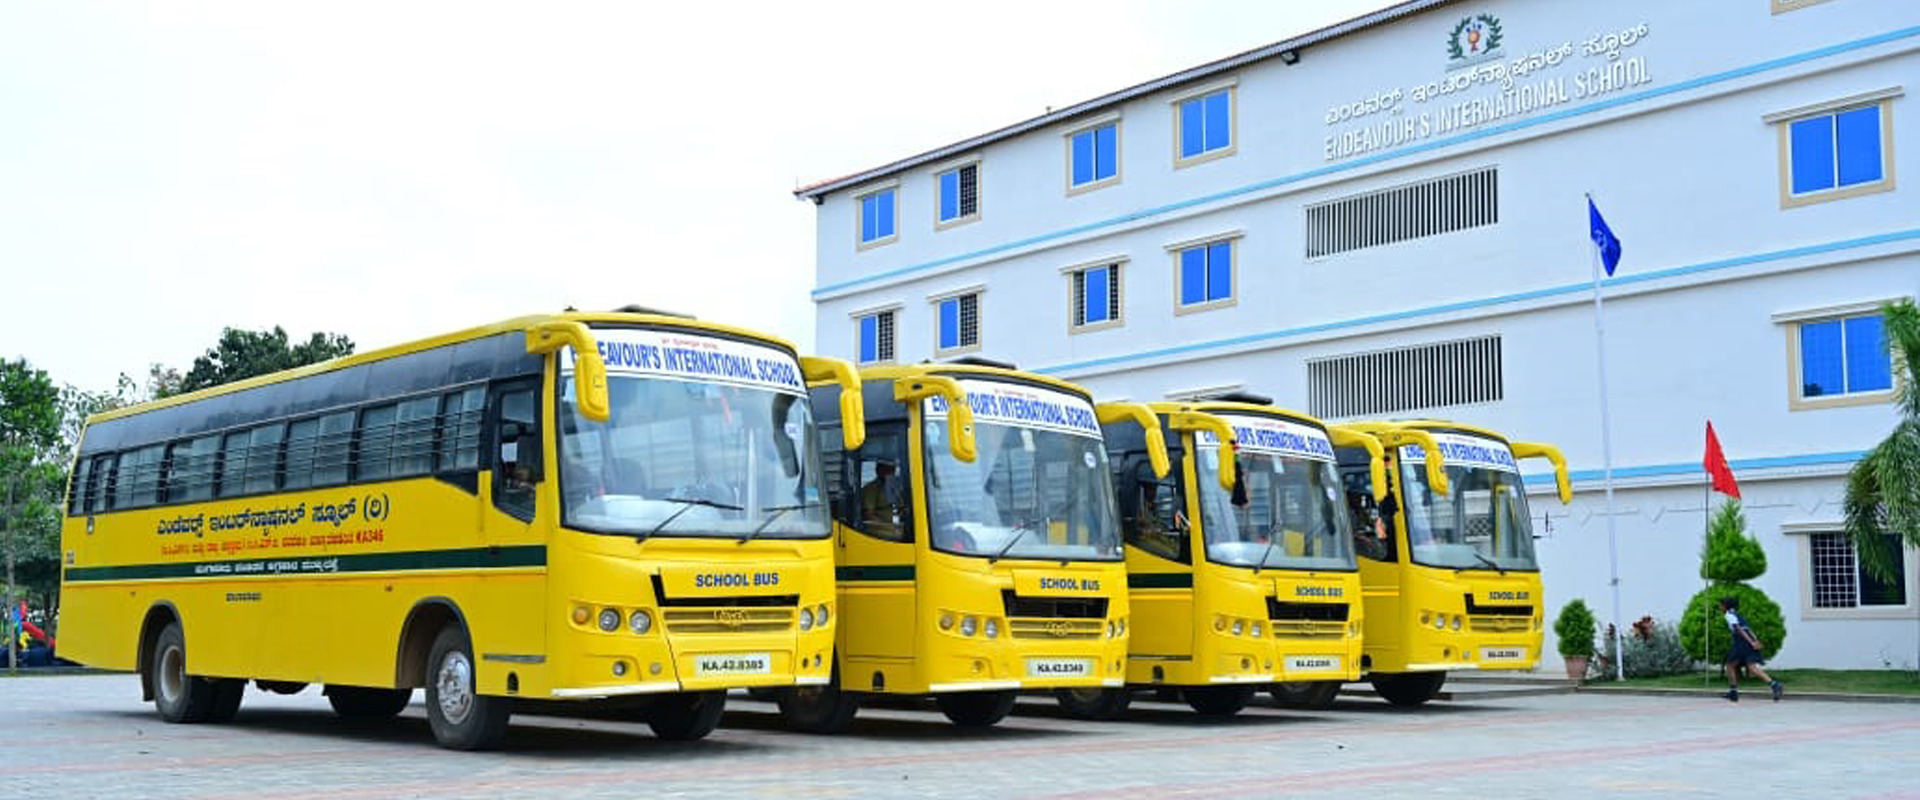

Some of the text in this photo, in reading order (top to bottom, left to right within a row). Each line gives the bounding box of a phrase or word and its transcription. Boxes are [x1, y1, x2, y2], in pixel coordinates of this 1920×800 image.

[1324, 56, 1652, 161] ENDEAVOUR'S INTERNATIONAL SCHOOL
[569, 340, 661, 369] EAVOUR'S
[662, 346, 757, 380] INTERNATIONAL
[757, 359, 799, 387] SCHOOL
[695, 572, 779, 588] SCHOOL BUS
[1040, 577, 1100, 591] SCHOOL BUS
